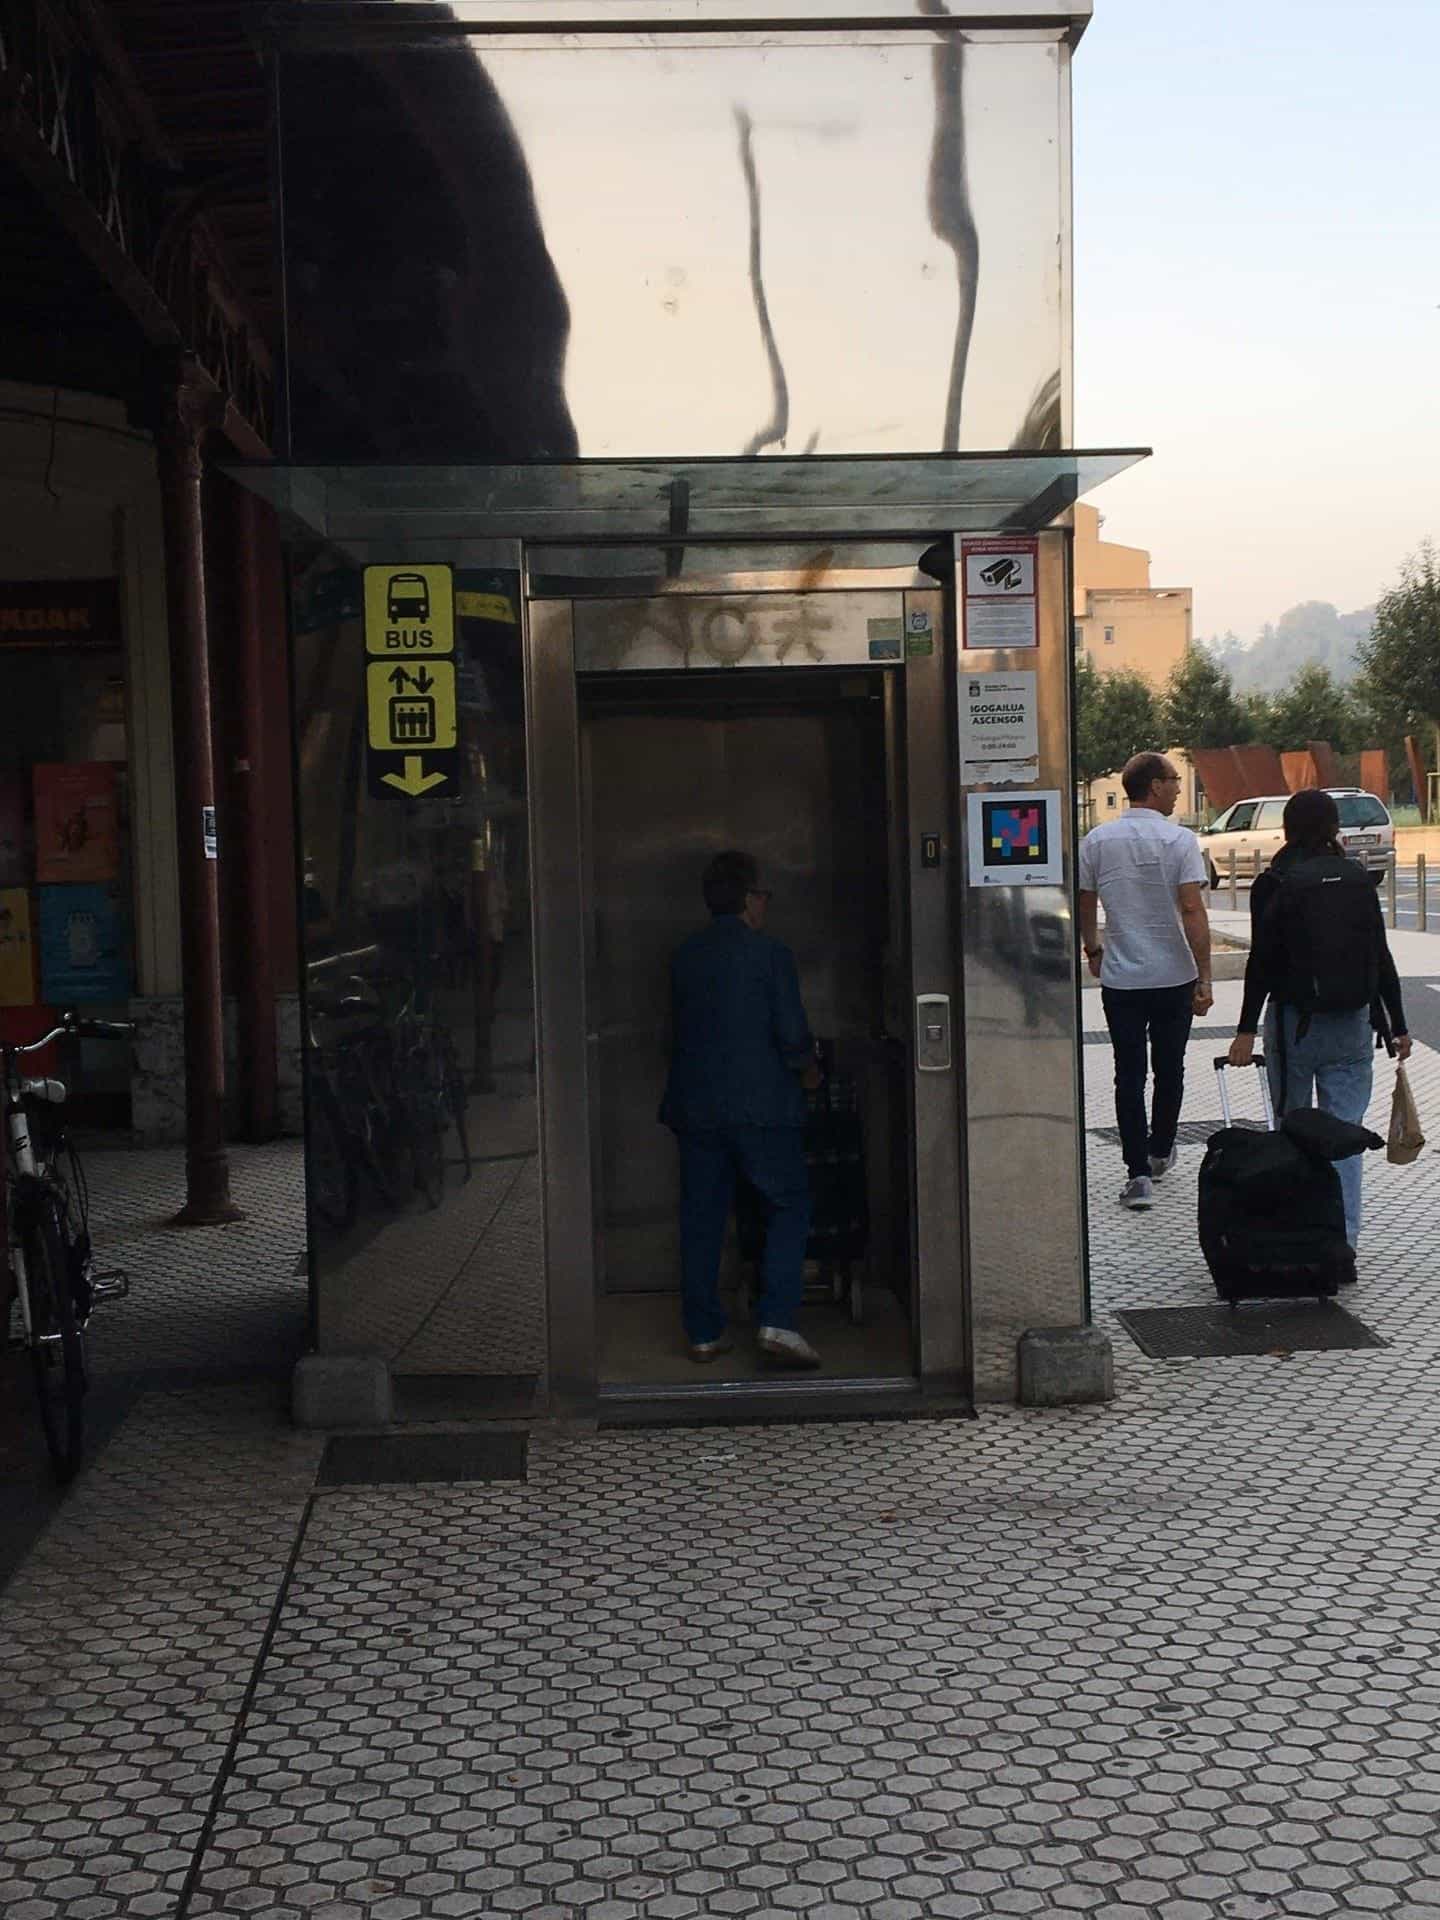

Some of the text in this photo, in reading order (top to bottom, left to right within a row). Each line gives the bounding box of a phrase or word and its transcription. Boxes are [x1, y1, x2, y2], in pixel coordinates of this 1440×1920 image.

[386, 630, 433, 648] BUS
[969, 703, 1025, 713] IGOGAILUA
[971, 715, 1024, 725] ASCENSOR
